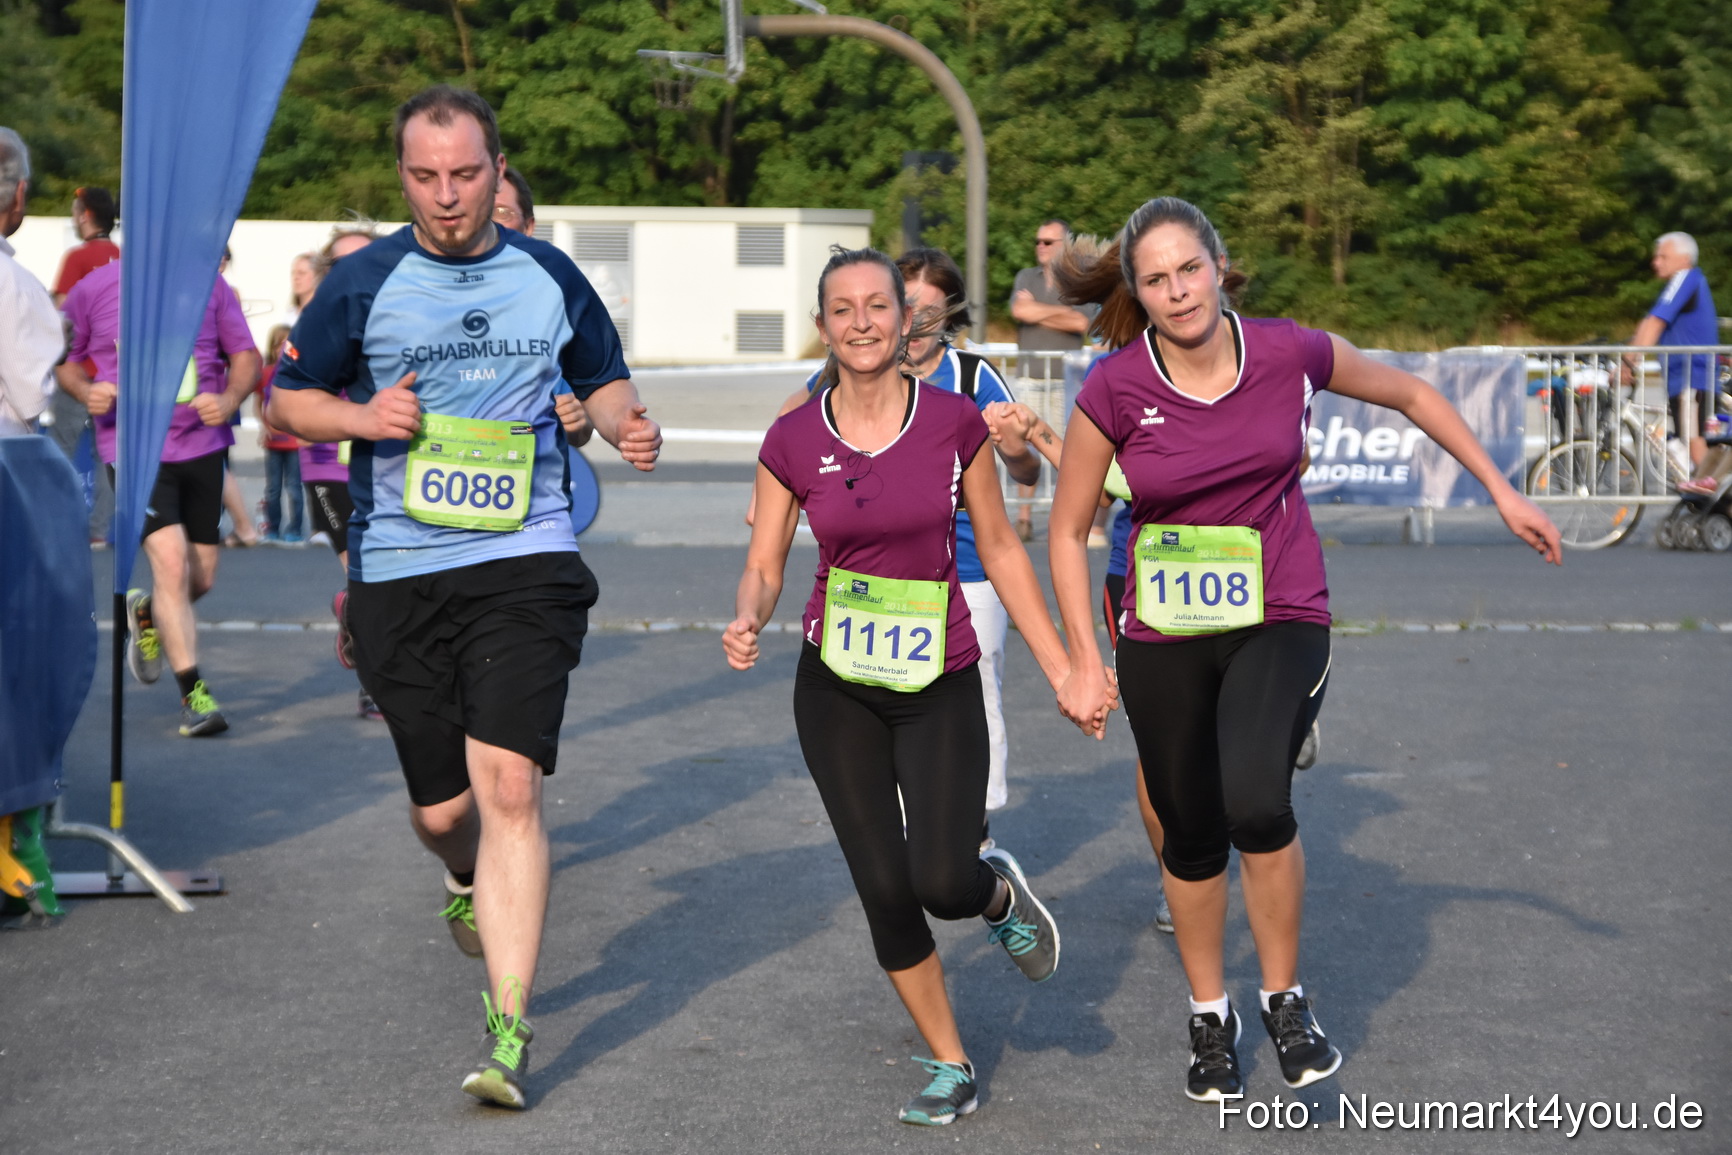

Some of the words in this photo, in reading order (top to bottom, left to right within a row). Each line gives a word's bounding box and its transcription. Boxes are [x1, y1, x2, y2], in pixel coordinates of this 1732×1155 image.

[401, 338, 551, 365] SCHABMÜLLER
[458, 367, 497, 382] TEAM
[1140, 416, 1165, 426] erima
[818, 464, 842, 474] erima
[420, 467, 516, 511] 6088
[1153, 543, 1196, 553] firmenlauf
[1150, 569, 1250, 607] 1108
[843, 589, 884, 604] firmenlauf
[1173, 613, 1192, 621] Julia
[837, 616, 932, 662] 1112
[852, 661, 877, 672] Sandra
[877, 665, 908, 675] Merbald
